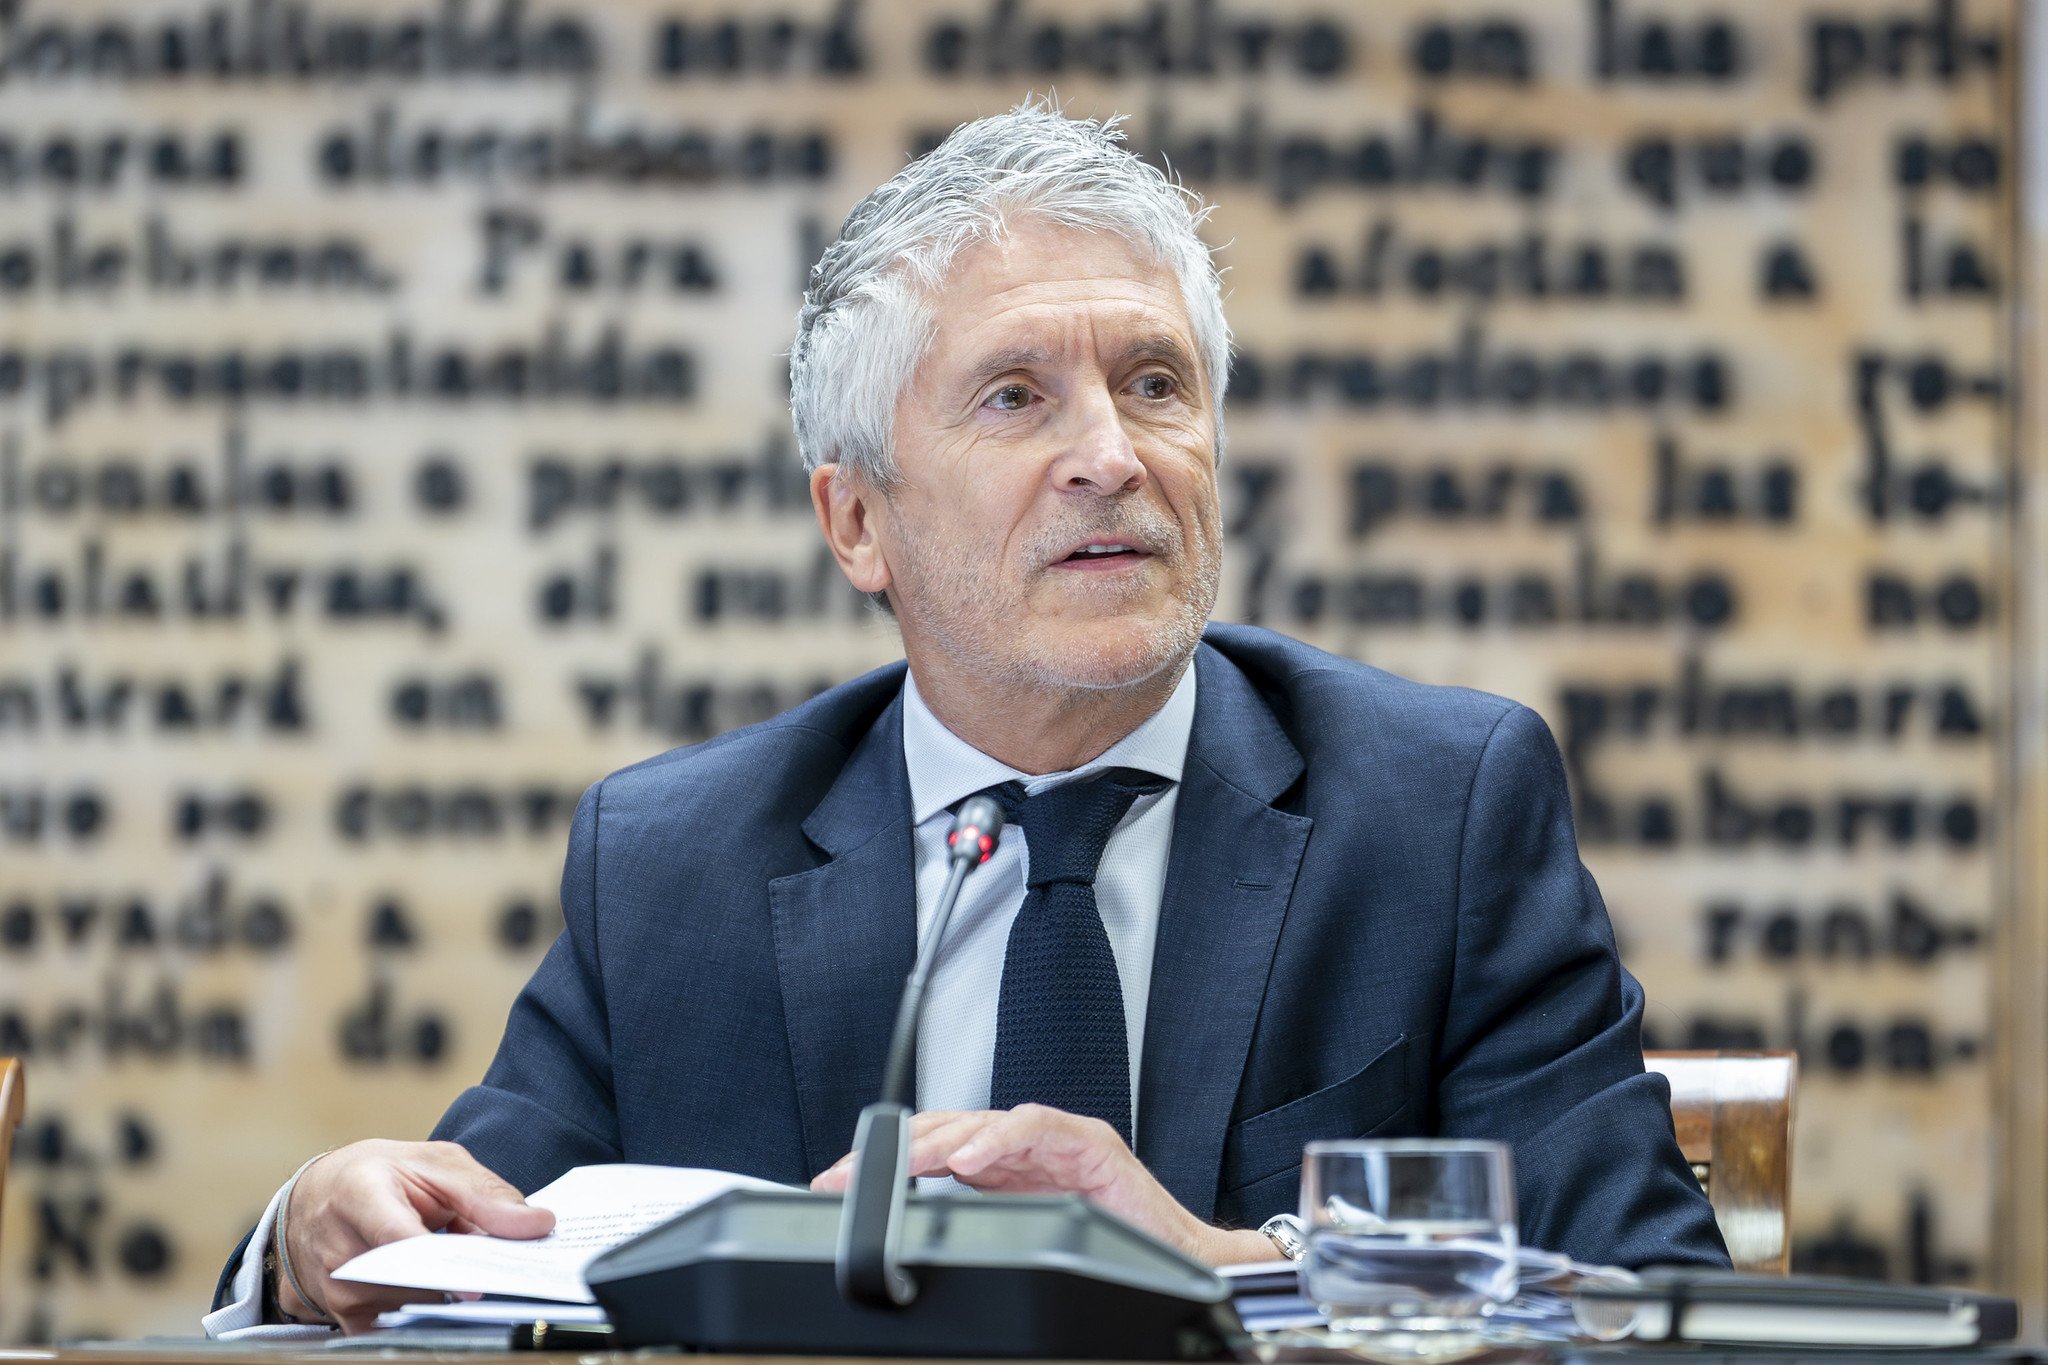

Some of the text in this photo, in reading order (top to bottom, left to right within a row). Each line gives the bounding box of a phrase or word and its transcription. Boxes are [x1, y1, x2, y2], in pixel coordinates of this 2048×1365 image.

[478, 210, 718, 294] Para
[1758, 240, 1818, 296] a
[1346, 456, 1588, 538] para
[1655, 432, 1800, 524] las
[1862, 568, 1990, 632] no
[390, 672, 505, 730] en
